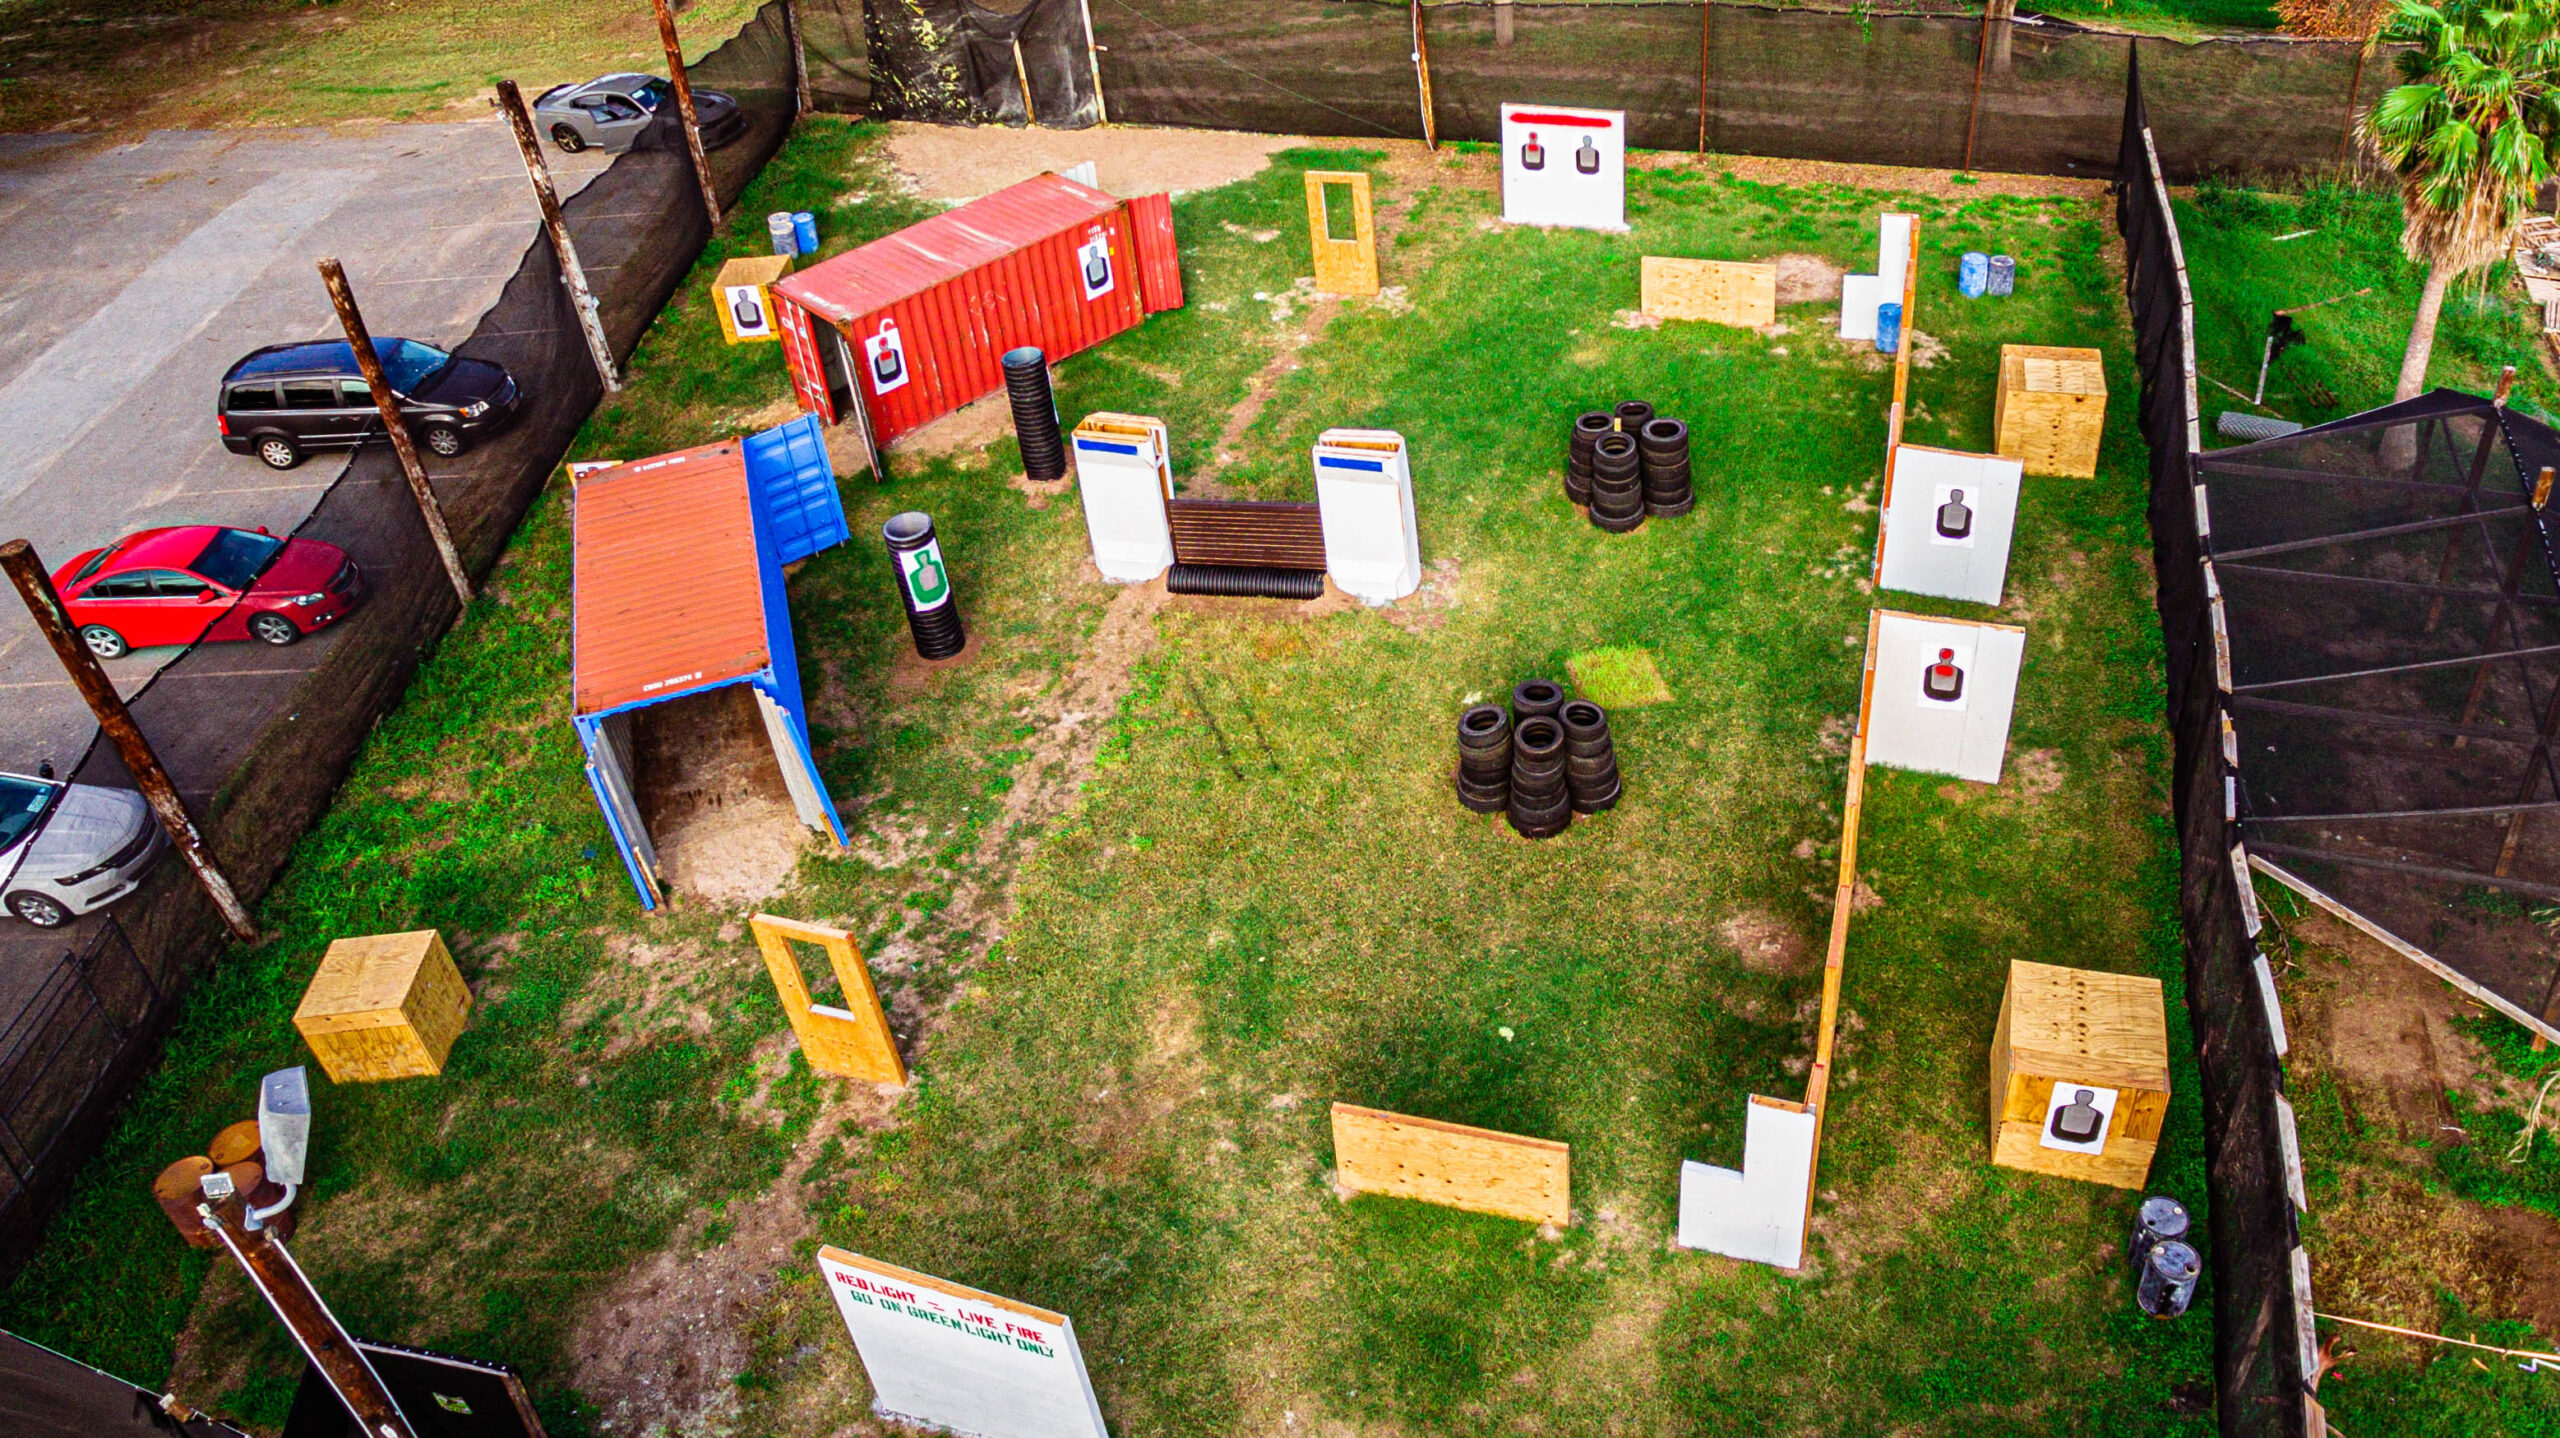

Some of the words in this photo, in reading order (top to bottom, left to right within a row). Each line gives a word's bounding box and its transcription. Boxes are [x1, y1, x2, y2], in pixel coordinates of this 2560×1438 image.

[835, 1271, 869, 1291] RED
[870, 1281, 916, 1304] LIGHT
[958, 1308, 998, 1330] LIVE
[1005, 1322, 1047, 1345] FIRE
[850, 1289, 875, 1306] GO
[880, 1298, 903, 1313] ON
[907, 1305, 963, 1332] GREEN
[964, 1322, 1012, 1346] LIGHT
[1016, 1338, 1055, 1359] ONLY
